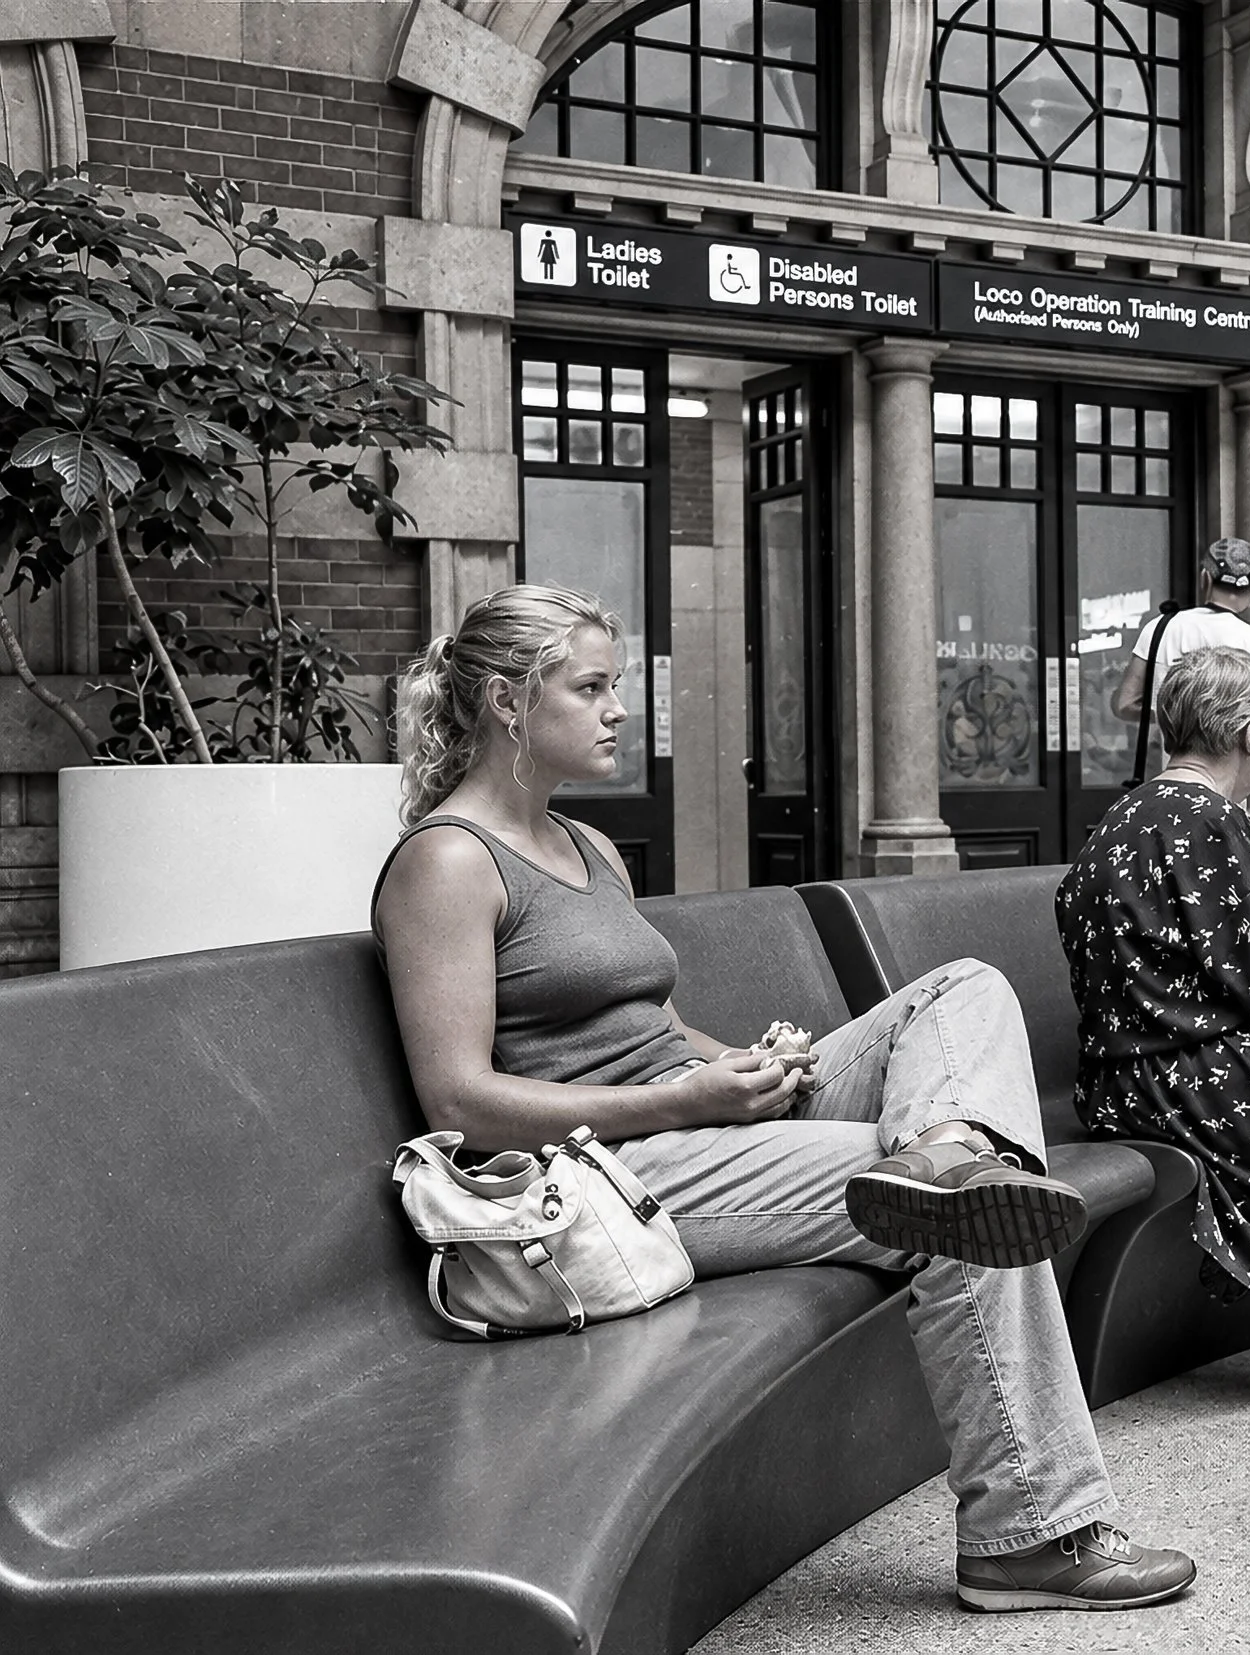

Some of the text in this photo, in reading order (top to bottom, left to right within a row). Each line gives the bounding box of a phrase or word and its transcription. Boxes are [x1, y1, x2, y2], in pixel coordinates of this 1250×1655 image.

[586, 235, 663, 265] Ladies
[586, 261, 651, 290] Toilet
[768, 256, 858, 287] Disabled
[768, 280, 918, 317] Persons Toilet
[974, 280, 1024, 306] Loco
[1030, 286, 1122, 316] Operation
[1127, 297, 1197, 328] Training
[974, 305, 1140, 339] (Authorised Persons Only)
